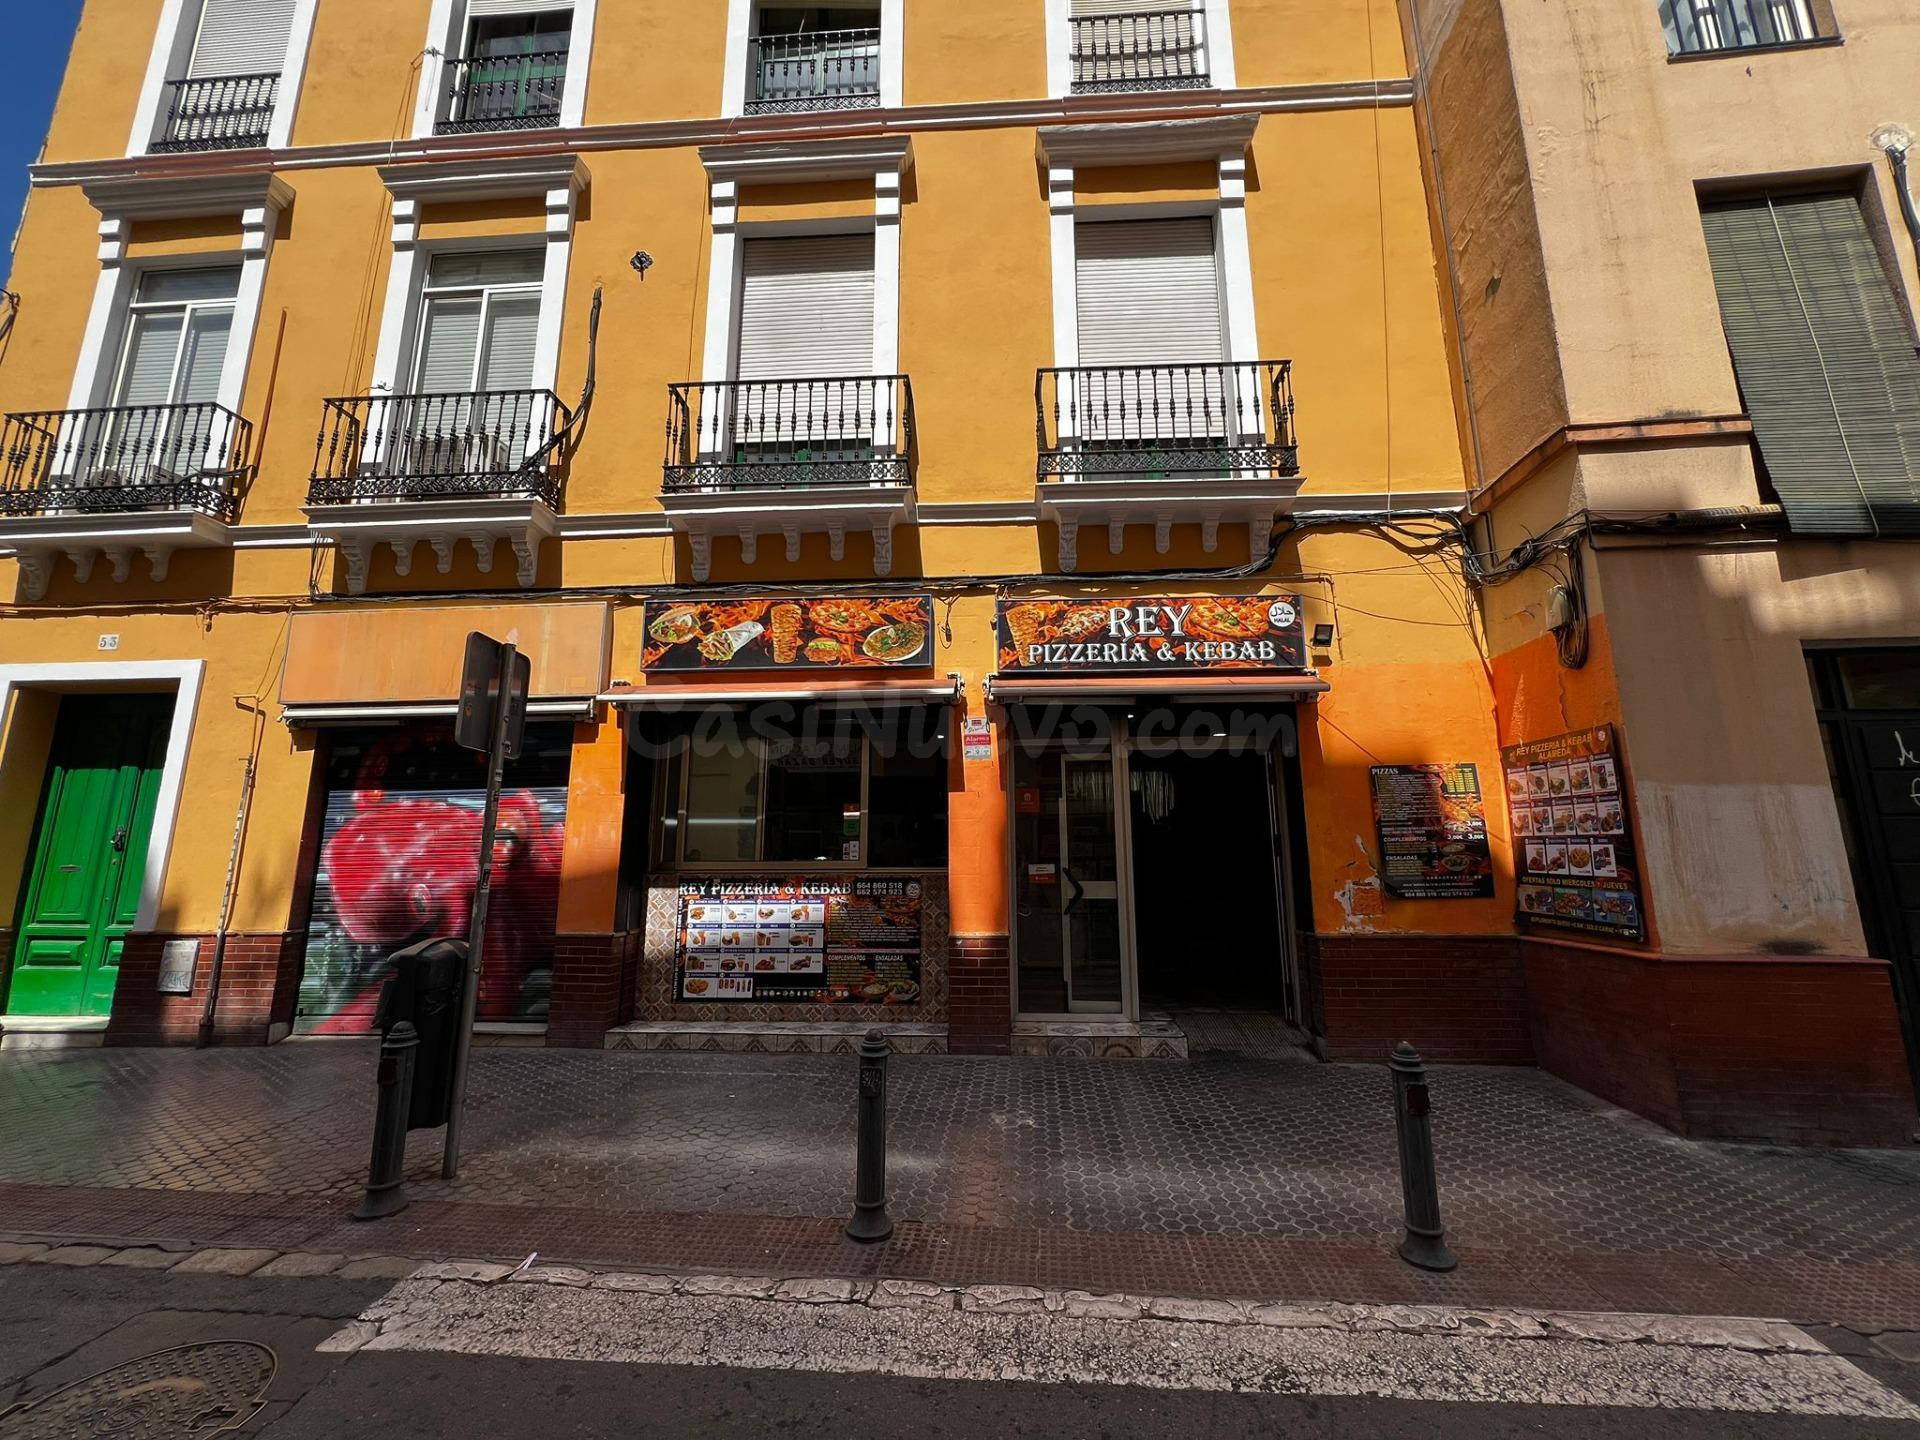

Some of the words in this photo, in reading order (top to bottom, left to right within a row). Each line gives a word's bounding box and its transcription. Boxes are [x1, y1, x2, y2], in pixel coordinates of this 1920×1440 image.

[1107, 604, 1193, 643] REY
[100, 636, 118, 648] 53
[1155, 645, 1176, 661] &
[1184, 640, 1276, 661] KEBAB
[1516, 746, 1531, 756] REY
[679, 881, 708, 895] REY
[784, 883, 796, 895] &
[800, 882, 851, 895] KEBAB
